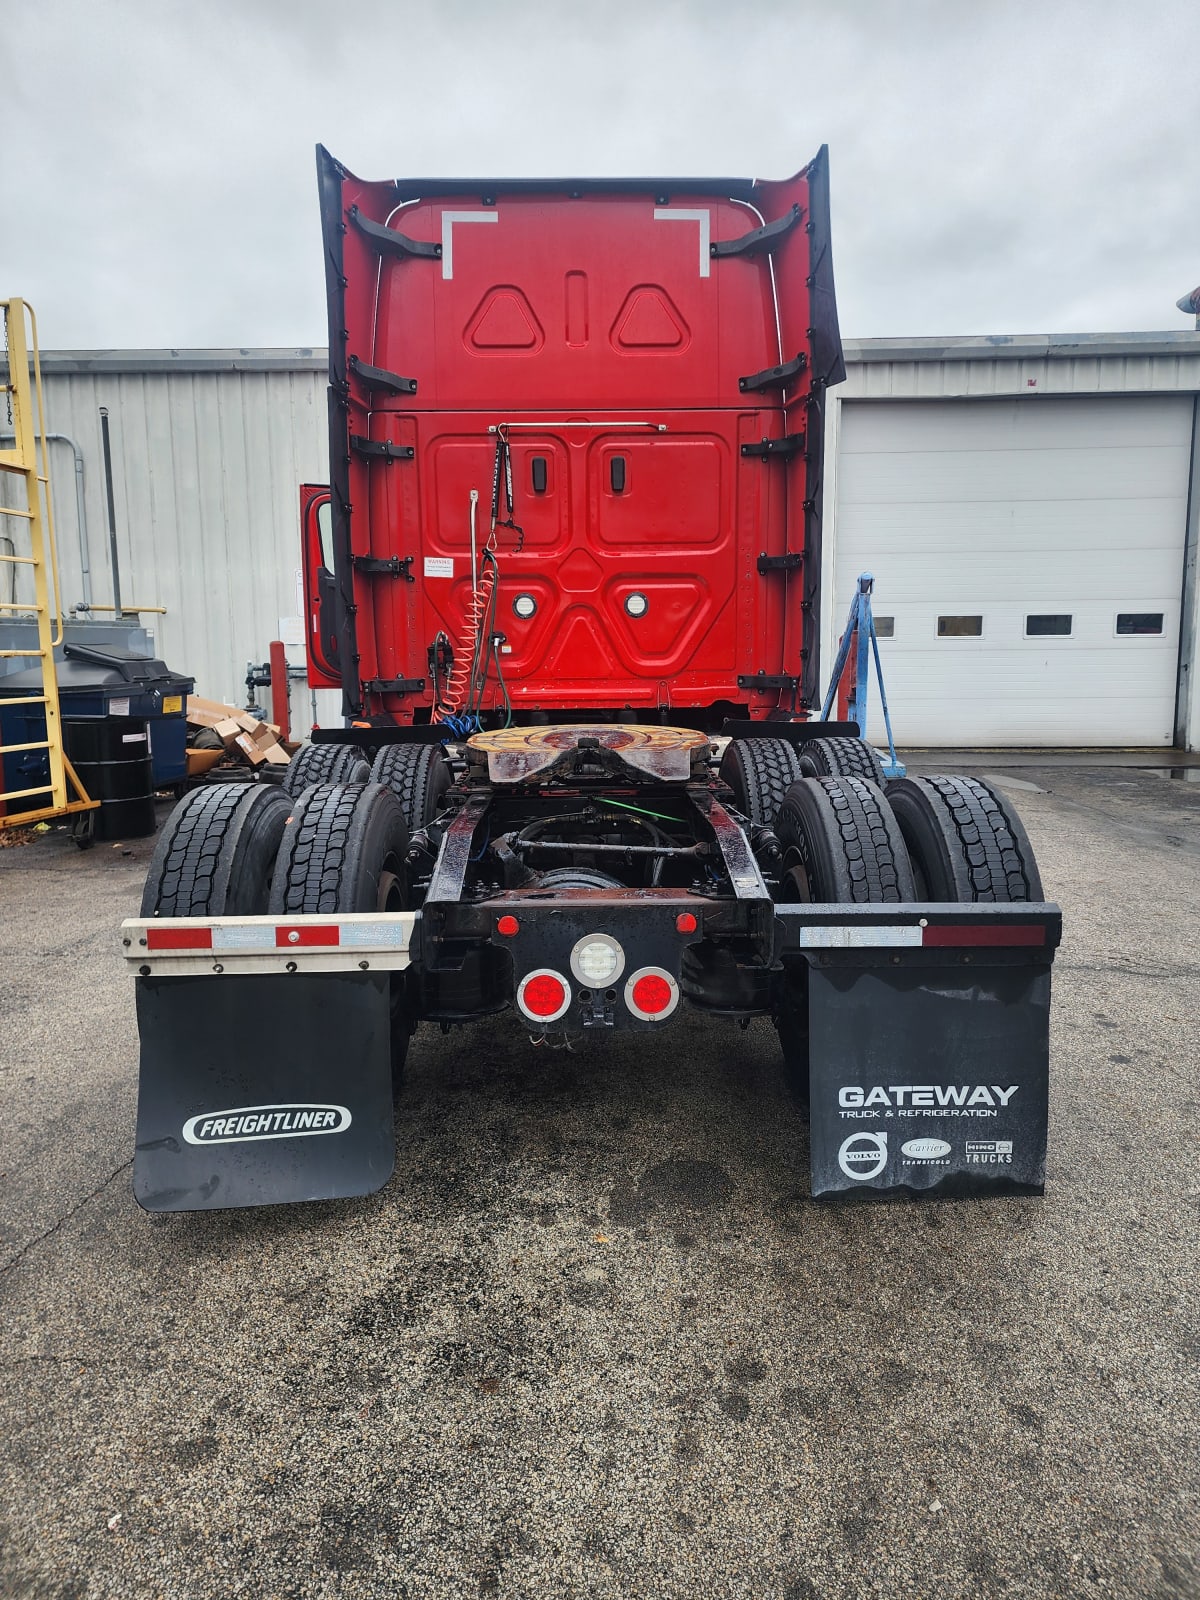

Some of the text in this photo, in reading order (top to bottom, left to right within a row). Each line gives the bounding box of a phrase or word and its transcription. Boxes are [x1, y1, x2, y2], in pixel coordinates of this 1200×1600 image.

[838, 1085, 1020, 1107] GATEWAY
[839, 1109, 997, 1118] TRUCK & REFRIGERATION
[199, 1111, 336, 1137] FREIGHTLINER
[909, 1143, 945, 1152] Carrier
[965, 1153, 1013, 1164] TRUCKS
